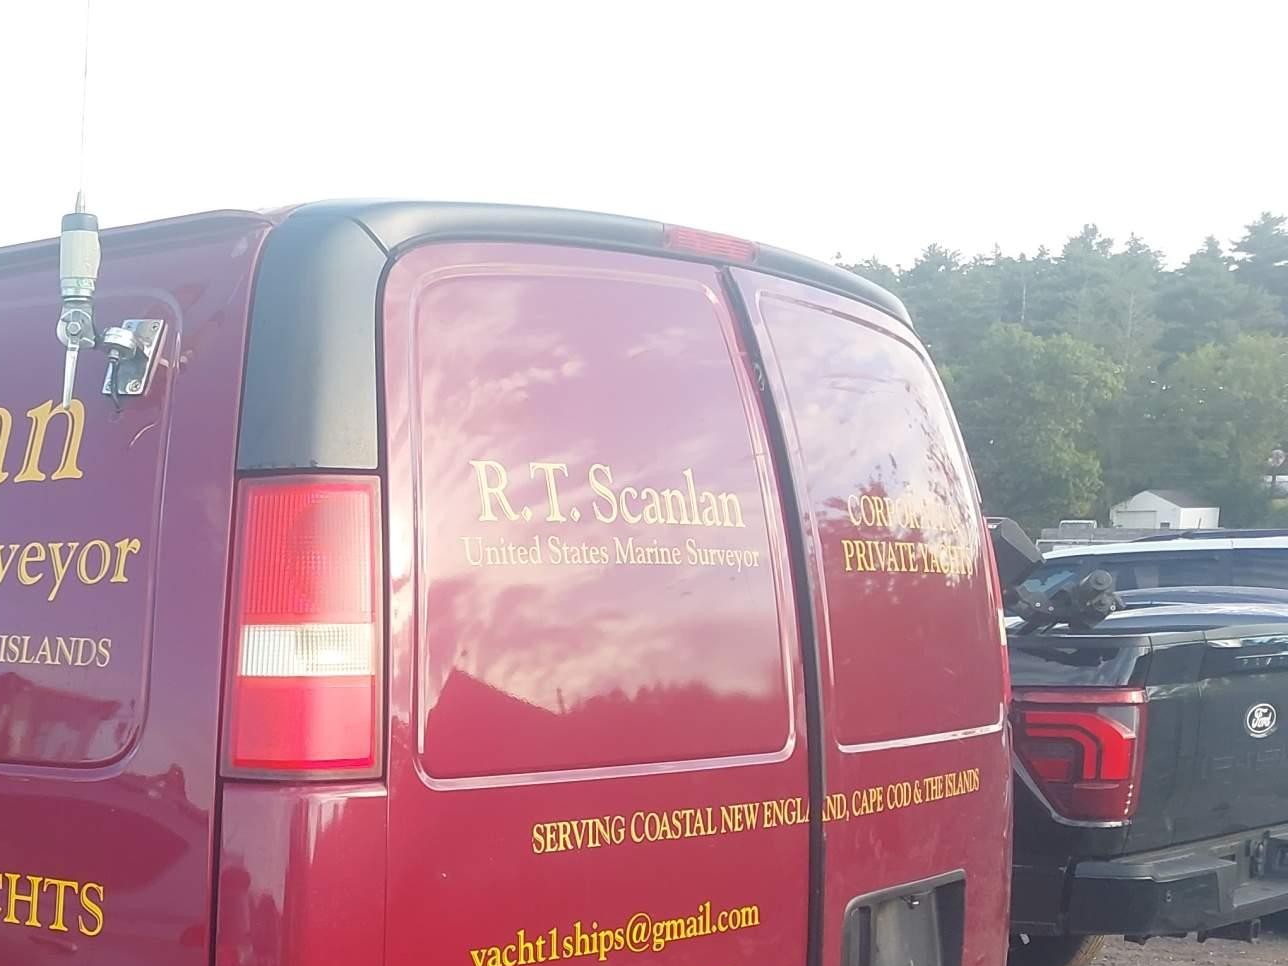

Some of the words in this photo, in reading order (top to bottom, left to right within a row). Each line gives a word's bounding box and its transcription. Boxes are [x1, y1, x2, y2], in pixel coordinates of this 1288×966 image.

[589, 463, 745, 528] Scanlan
[461, 535, 542, 566] United
[547, 535, 609, 566] States
[613, 536, 682, 566] Marine
[686, 538, 760, 573] Surveyor
[841, 539, 919, 572] PRIVATE
[532, 816, 626, 855] SERVING
[630, 807, 717, 843] COASTAL
[720, 802, 760, 835] NEW
[852, 786, 883, 817] CAPE
[886, 781, 912, 810] COD
[913, 779, 922, 805] &
[923, 775, 944, 802] THE
[944, 768, 980, 799] ISLANDS
